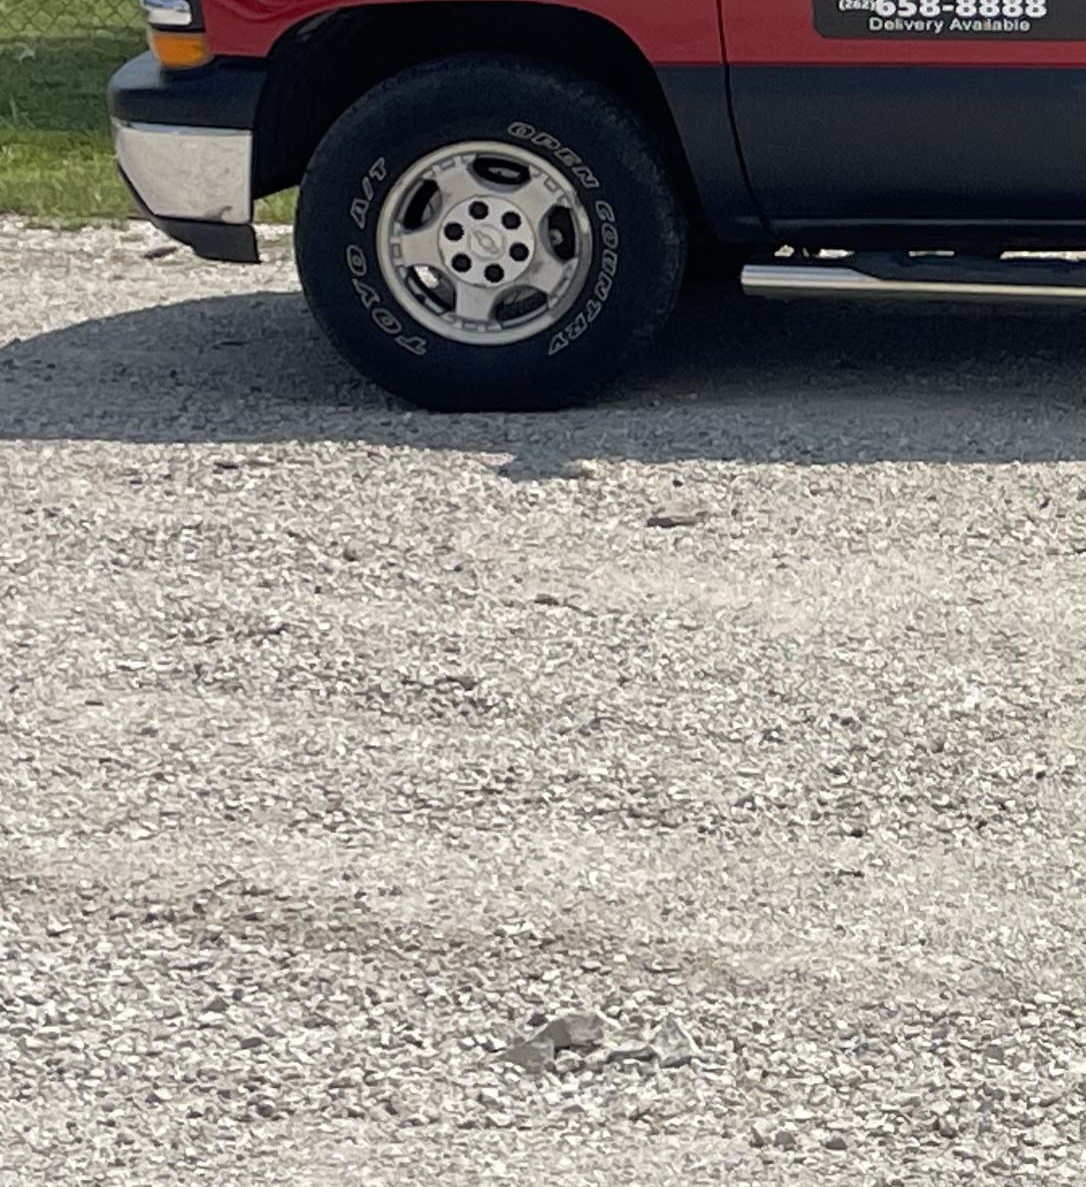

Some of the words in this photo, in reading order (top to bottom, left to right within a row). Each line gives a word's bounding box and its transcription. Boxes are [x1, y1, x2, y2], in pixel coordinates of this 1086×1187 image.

[868, 16, 944, 34] Delivery
[949, 17, 1031, 31] Available
[507, 122, 600, 189] OPEN
[348, 156, 386, 230] A/T
[346, 244, 429, 356] TOYO
[549, 200, 619, 355] COUNTRY
